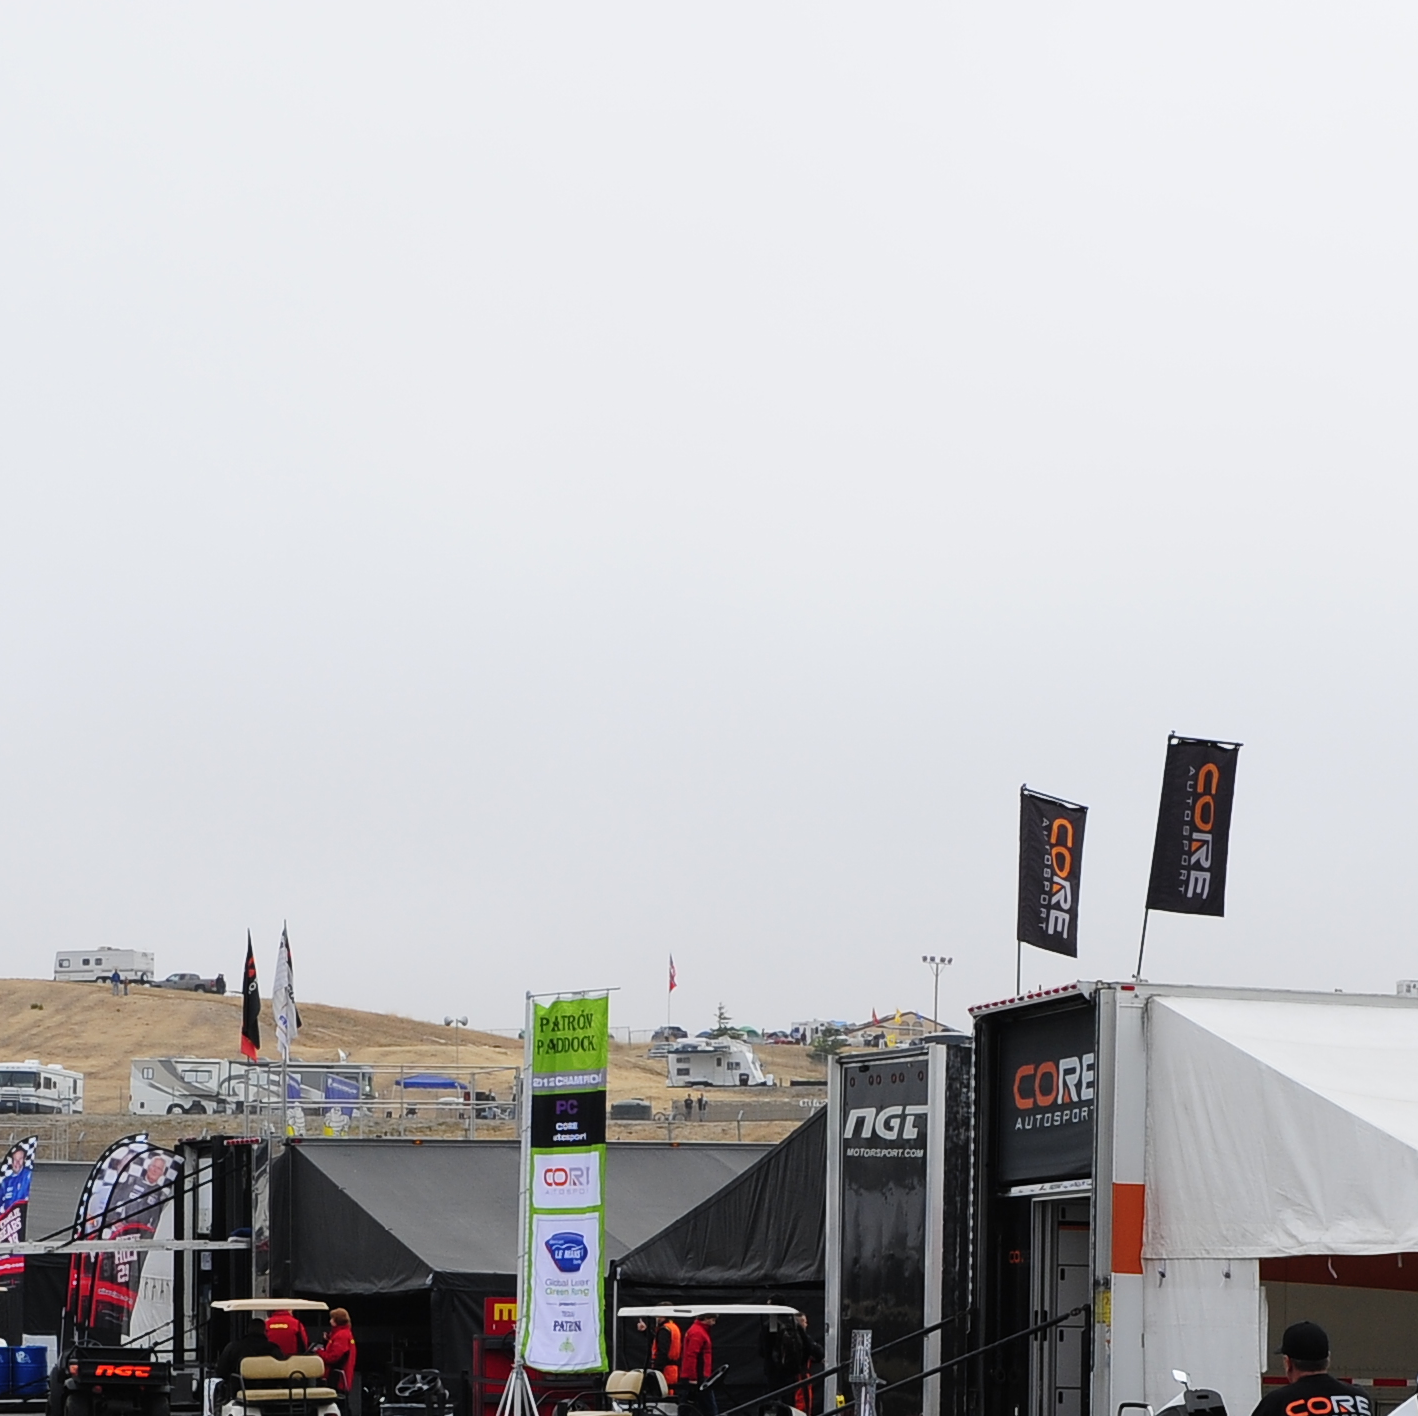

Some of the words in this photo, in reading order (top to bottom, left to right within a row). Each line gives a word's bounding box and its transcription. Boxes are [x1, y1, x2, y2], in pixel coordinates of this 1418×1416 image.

[1178, 765, 1196, 895] AUTOSPORT
[1186, 762, 1220, 900] CORE
[1047, 817, 1074, 939] CORE
[536, 1034, 597, 1056] PADDOCK
[1013, 1053, 1094, 1110] CORE
[555, 1099, 579, 1115] PC
[1014, 1104, 1094, 1131] AUTOSPOR
[846, 1147, 924, 1158] MOTORSPORT.COM
